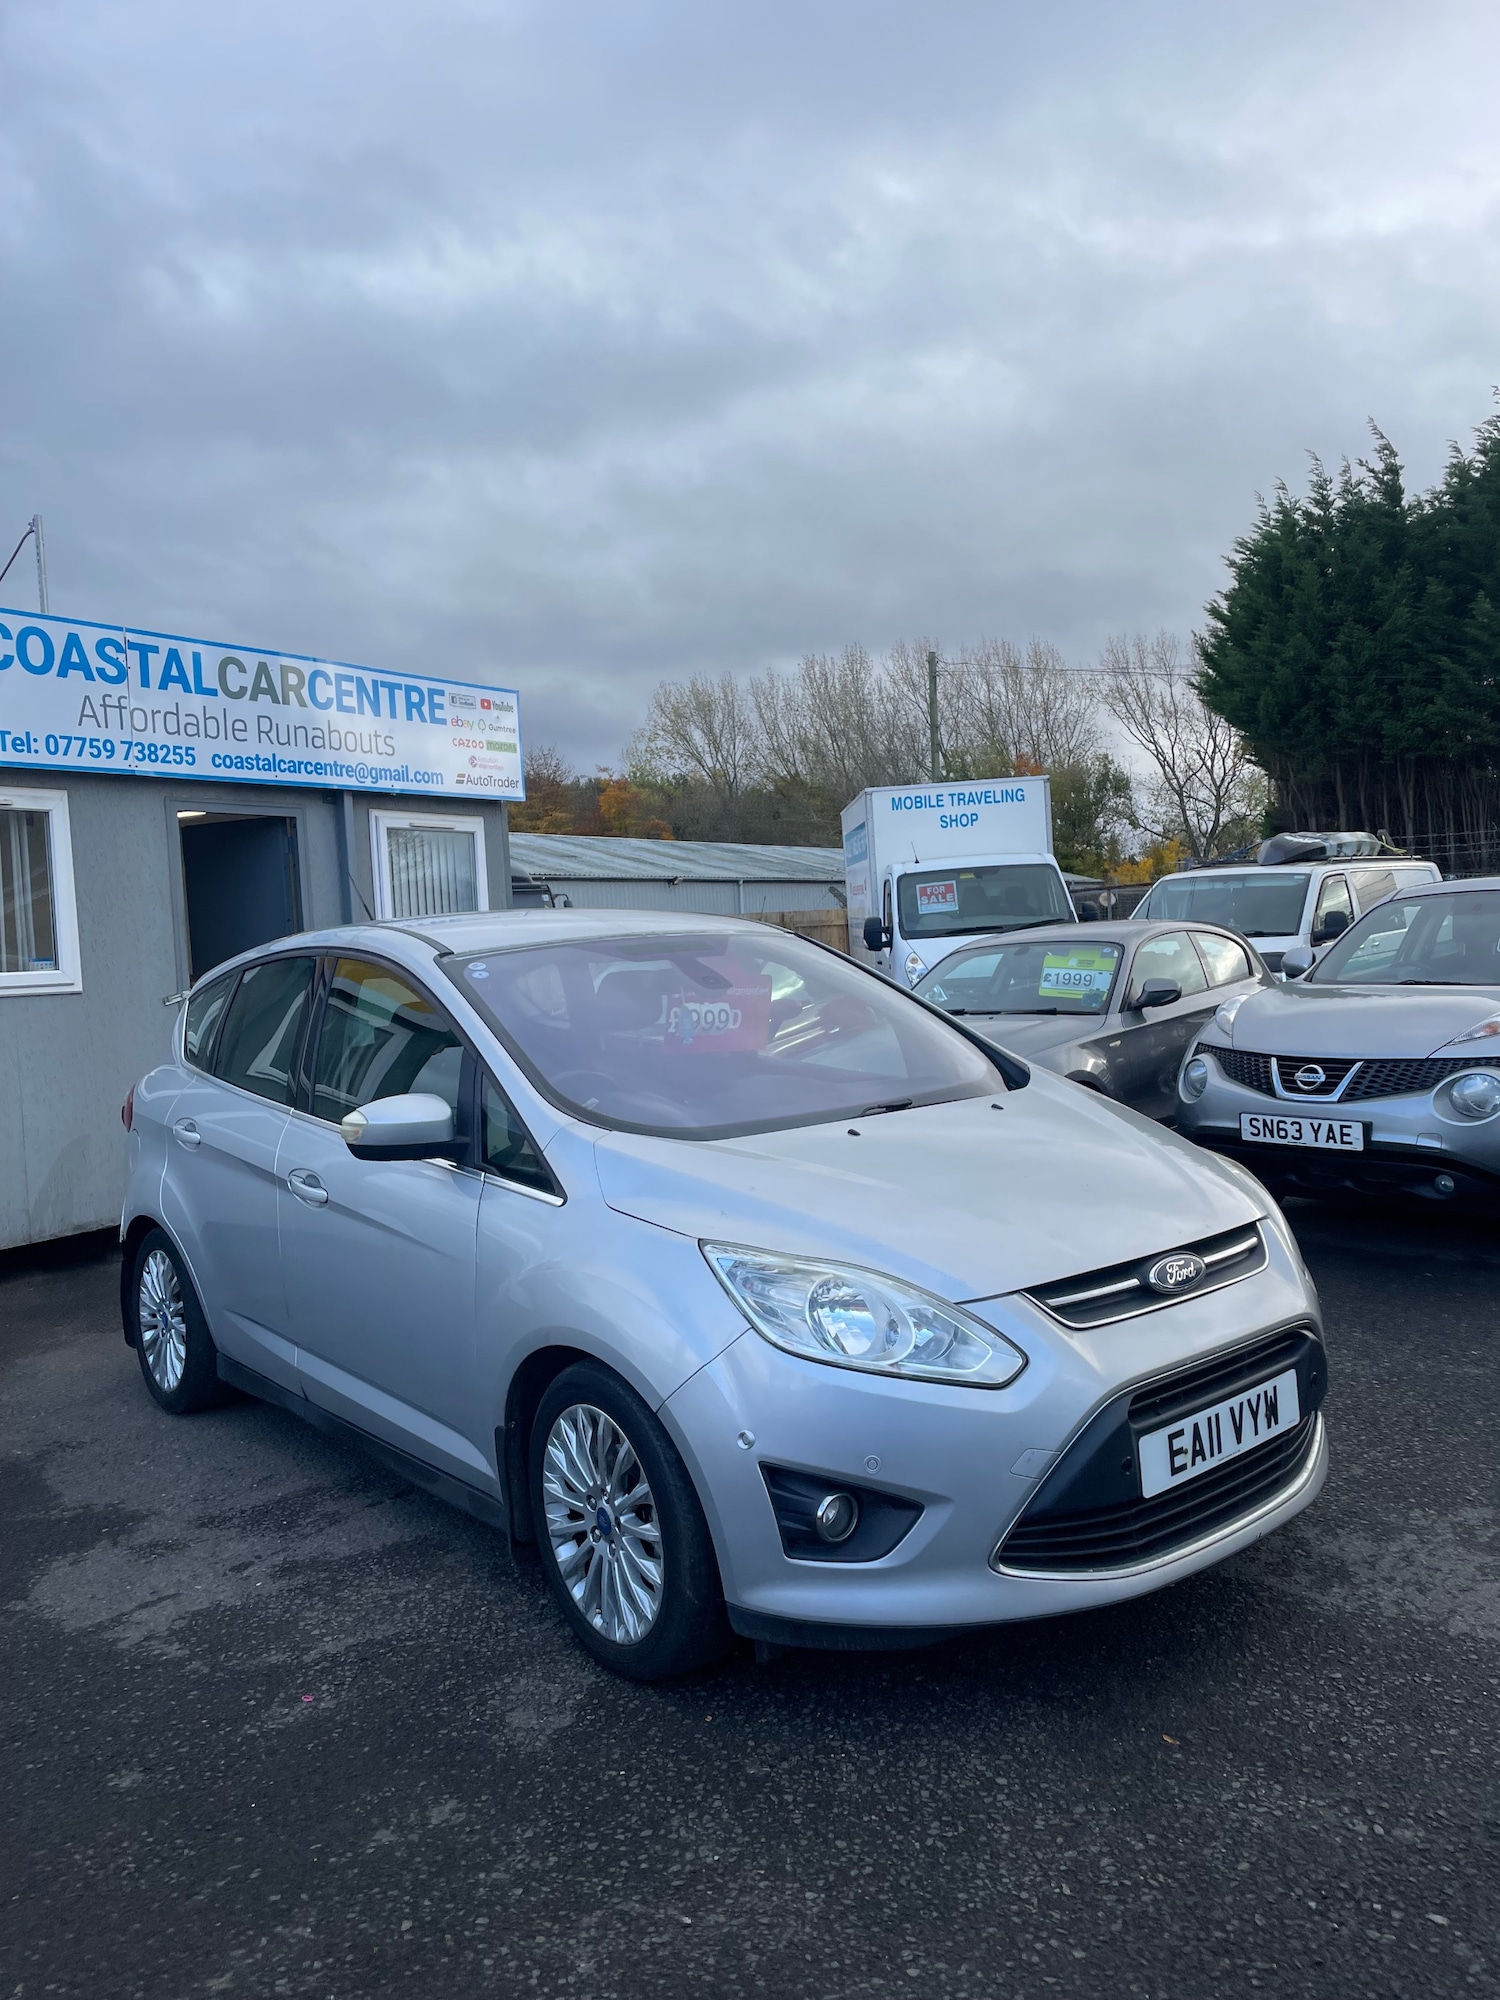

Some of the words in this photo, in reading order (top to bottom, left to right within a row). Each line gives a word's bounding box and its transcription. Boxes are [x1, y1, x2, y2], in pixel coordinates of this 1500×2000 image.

[492, 699, 514, 713] YouTube
[78, 693, 248, 743] Affordable
[257, 714, 396, 757] Runabouts
[450, 715, 474, 731] ebay
[488, 723, 516, 734] Gumtree
[0, 730, 39, 754] Tel:
[45, 733, 116, 761] 07759
[120, 740, 196, 766] 738255
[211, 752, 444, 786] coastalcarcentre@gmail.com
[466, 773, 520, 789] AutoTrader
[891, 793, 945, 811] MOBILE
[948, 787, 1026, 807] TRAVELING
[939, 812, 979, 829] SHOP
[926, 885, 946, 895] FOR
[920, 892, 955, 905] SALE
[1042, 971, 1093, 987] £1999
[1295, 1073, 1323, 1081] NISSAN
[1249, 1117, 1303, 1141] SN63
[1310, 1122, 1354, 1146] YAE
[1165, 1259, 1197, 1284] Ford
[1167, 1412, 1222, 1477] EA11
[1229, 1385, 1279, 1445] VYW
